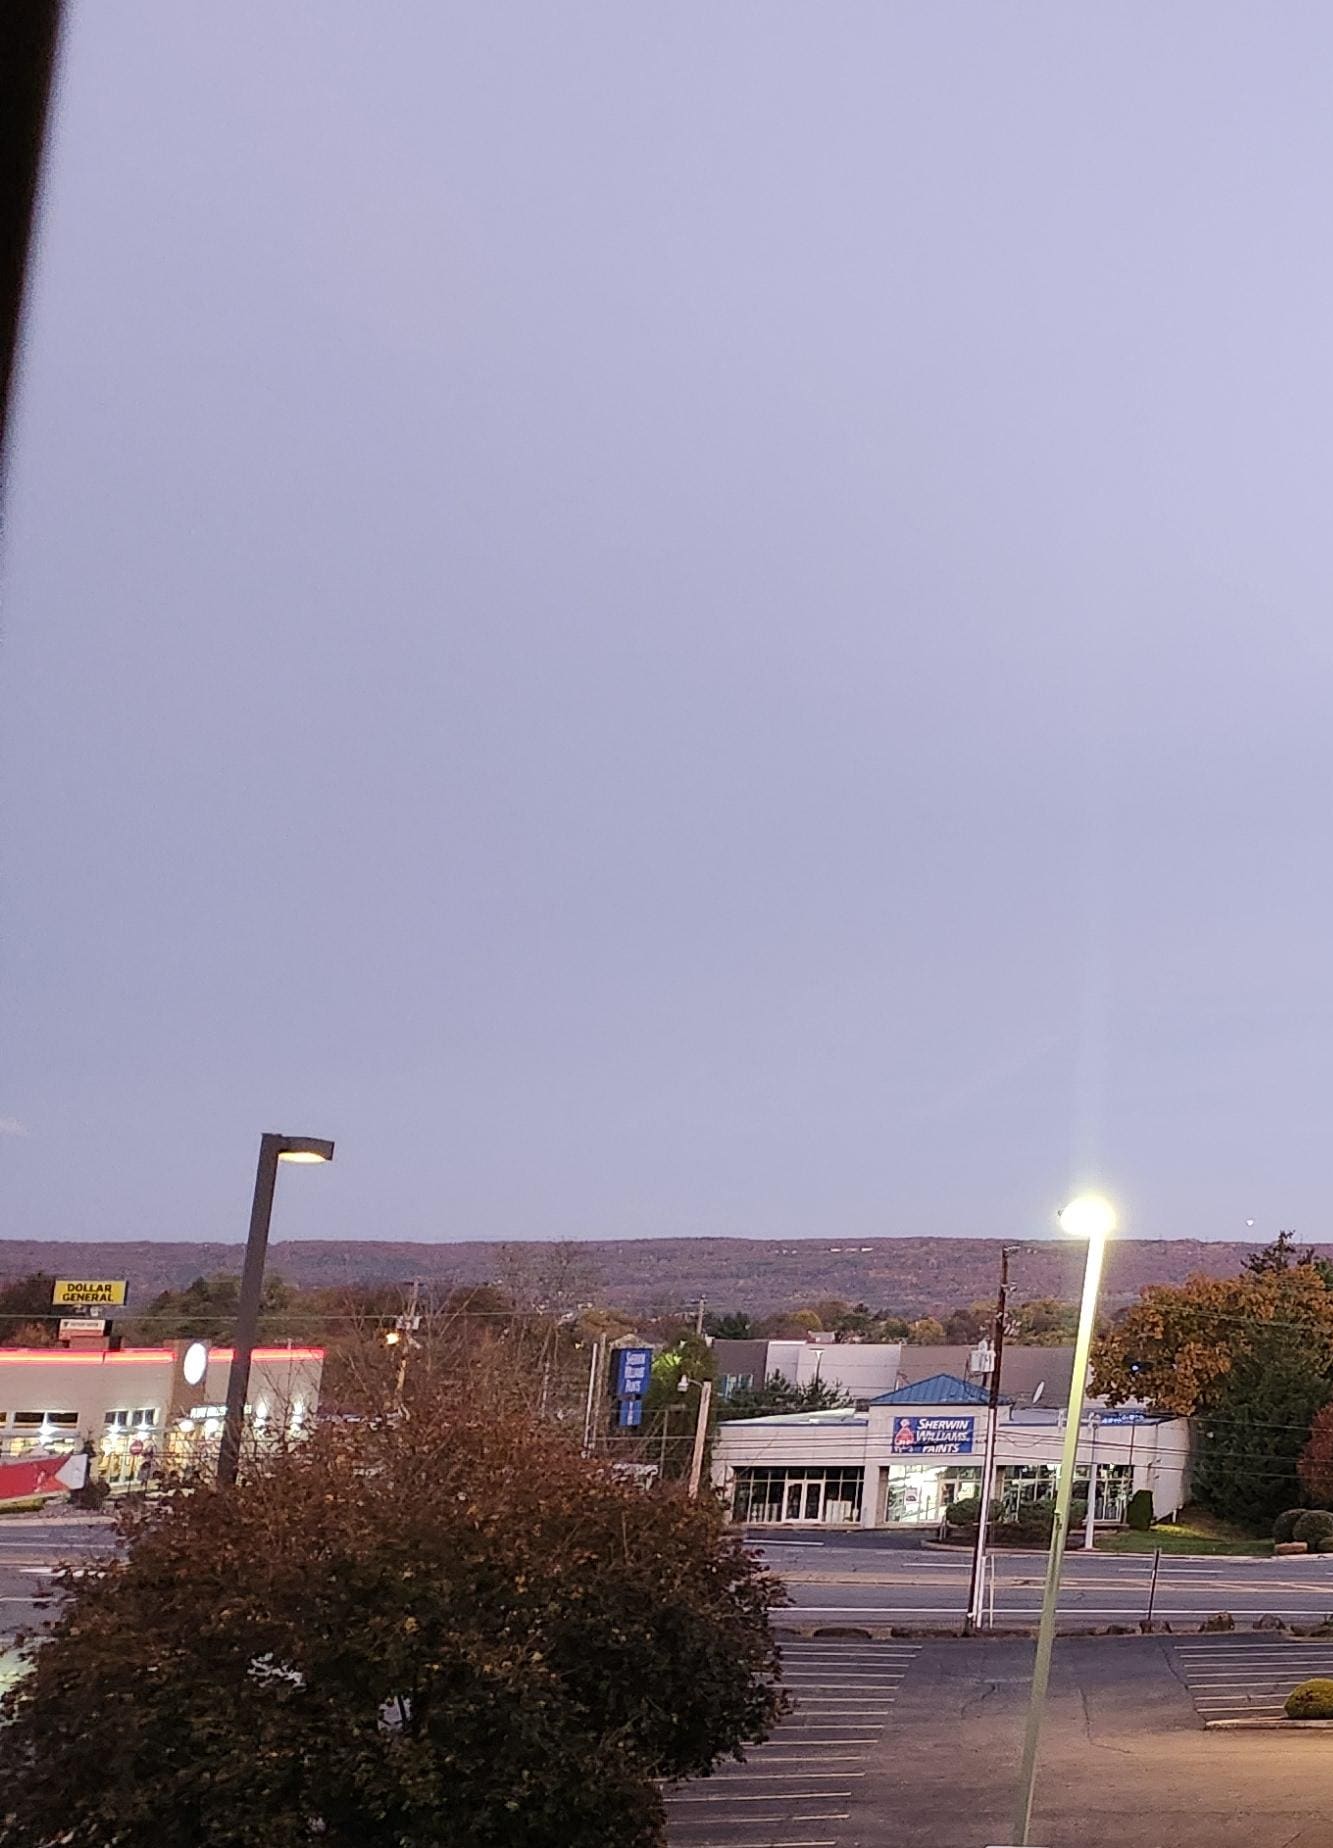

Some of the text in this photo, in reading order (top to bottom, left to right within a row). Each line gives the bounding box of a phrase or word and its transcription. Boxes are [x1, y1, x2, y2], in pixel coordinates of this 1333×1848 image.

[67, 1283, 112, 1293] DOLLAR
[62, 1292, 114, 1302] GENERAL
[916, 1418, 968, 1430] SHERWIN
[916, 1429, 968, 1442] WILLIAMS
